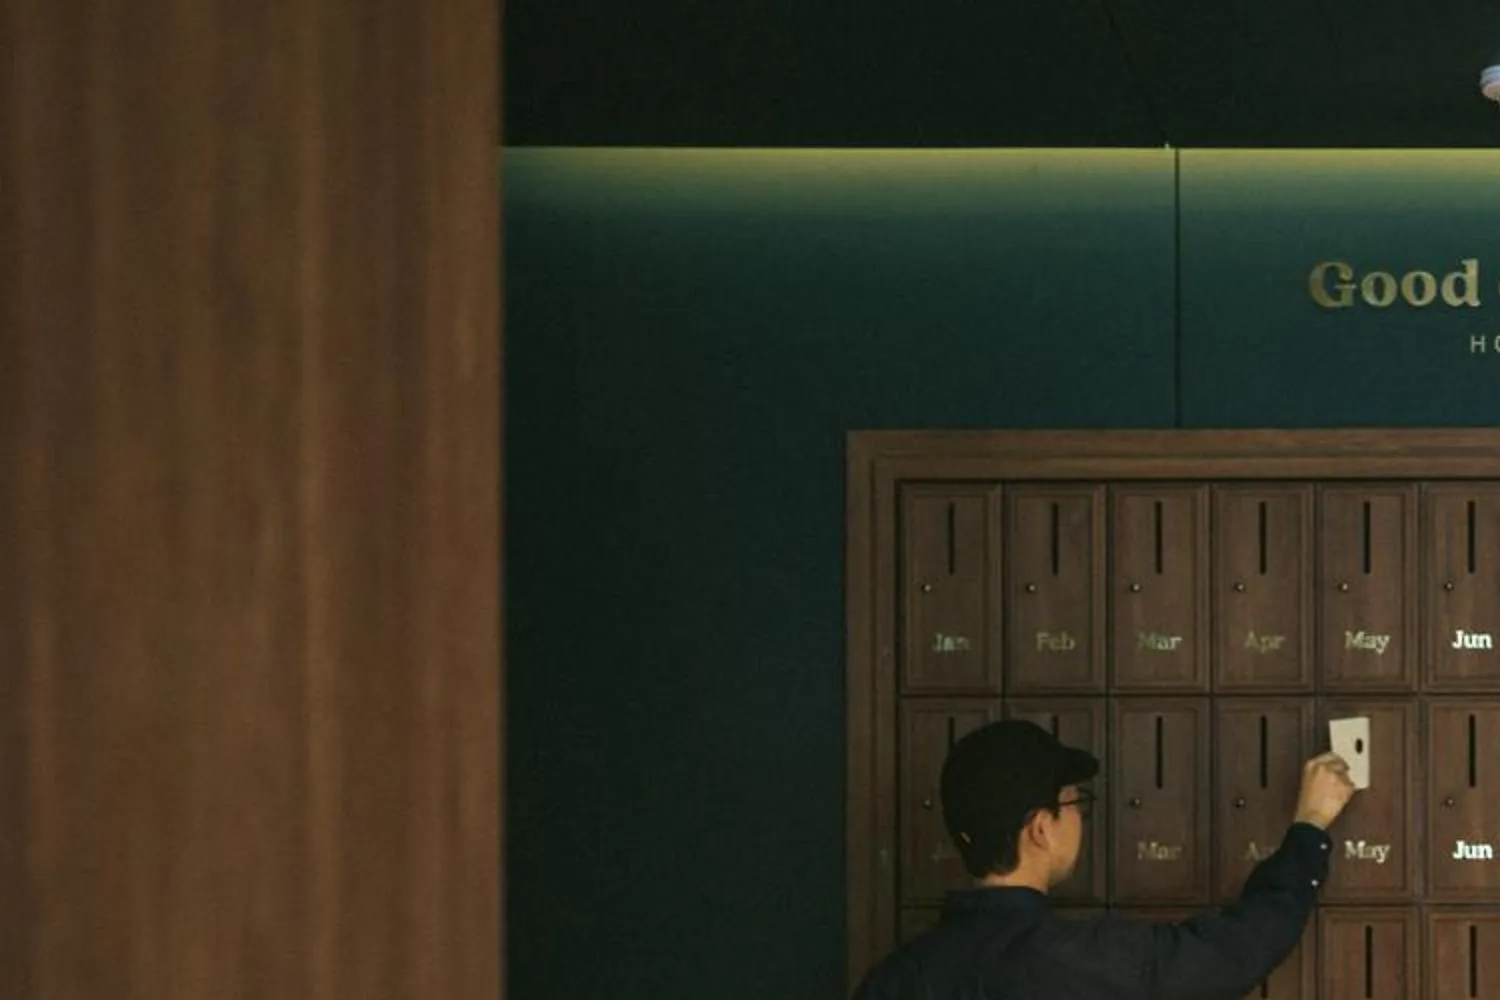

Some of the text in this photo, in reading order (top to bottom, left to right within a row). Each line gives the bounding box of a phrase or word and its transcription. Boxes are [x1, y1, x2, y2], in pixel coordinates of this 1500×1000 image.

[1308, 259, 1481, 307] Good
[1036, 632, 1076, 651] Feb
[1138, 633, 1182, 651] Mar
[1244, 632, 1285, 652] Apr
[1345, 631, 1391, 654] May
[1452, 630, 1493, 650] Jun
[1345, 840, 1390, 864] May
[1453, 840, 1493, 860] Jun
